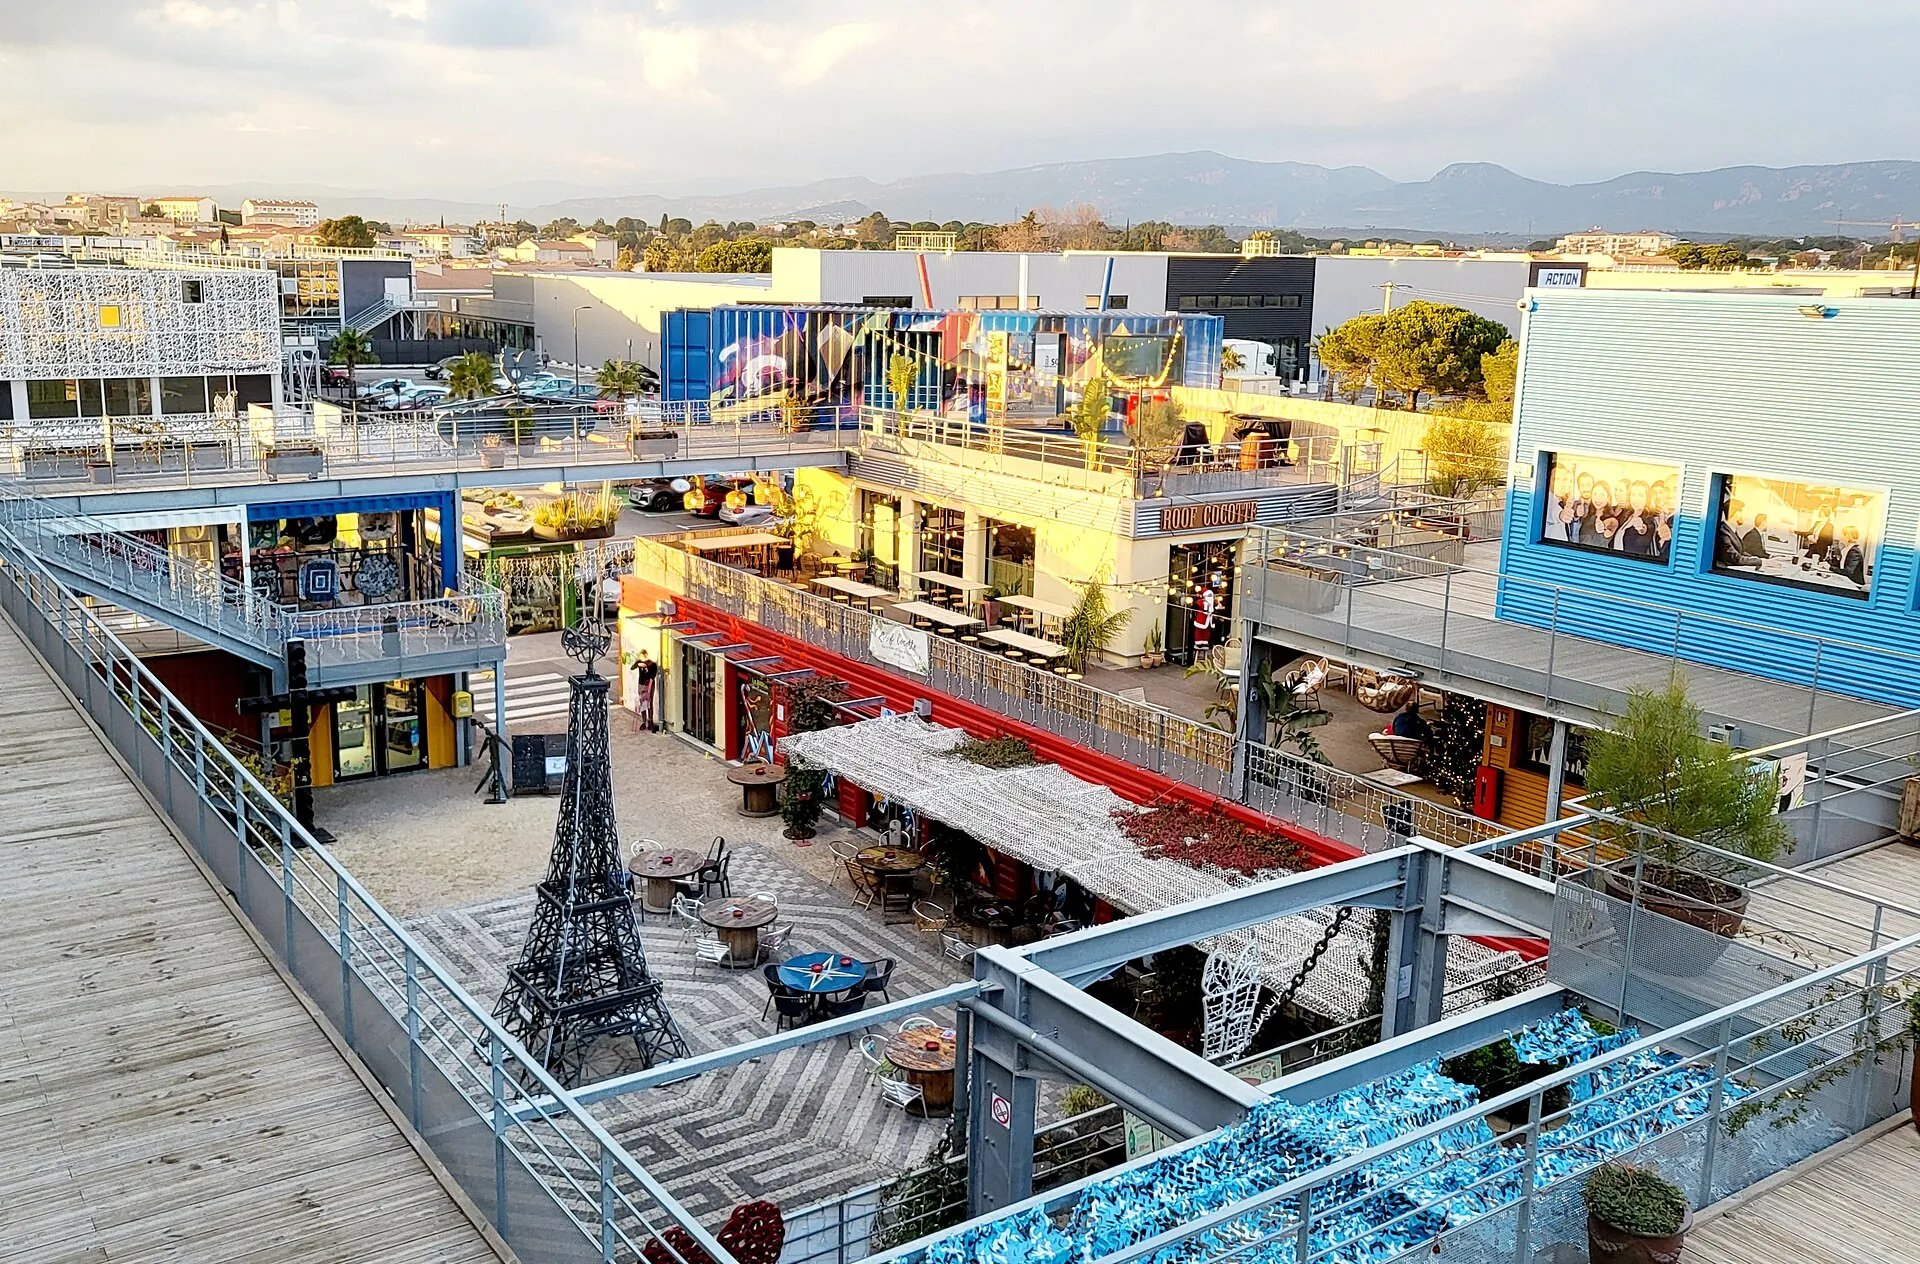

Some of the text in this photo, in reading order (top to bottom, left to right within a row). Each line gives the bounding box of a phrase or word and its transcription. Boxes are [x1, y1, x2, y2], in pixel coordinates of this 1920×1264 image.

[1545, 272, 1579, 285] ACTION
[1162, 501, 1258, 530] ROOF COCOTTE
